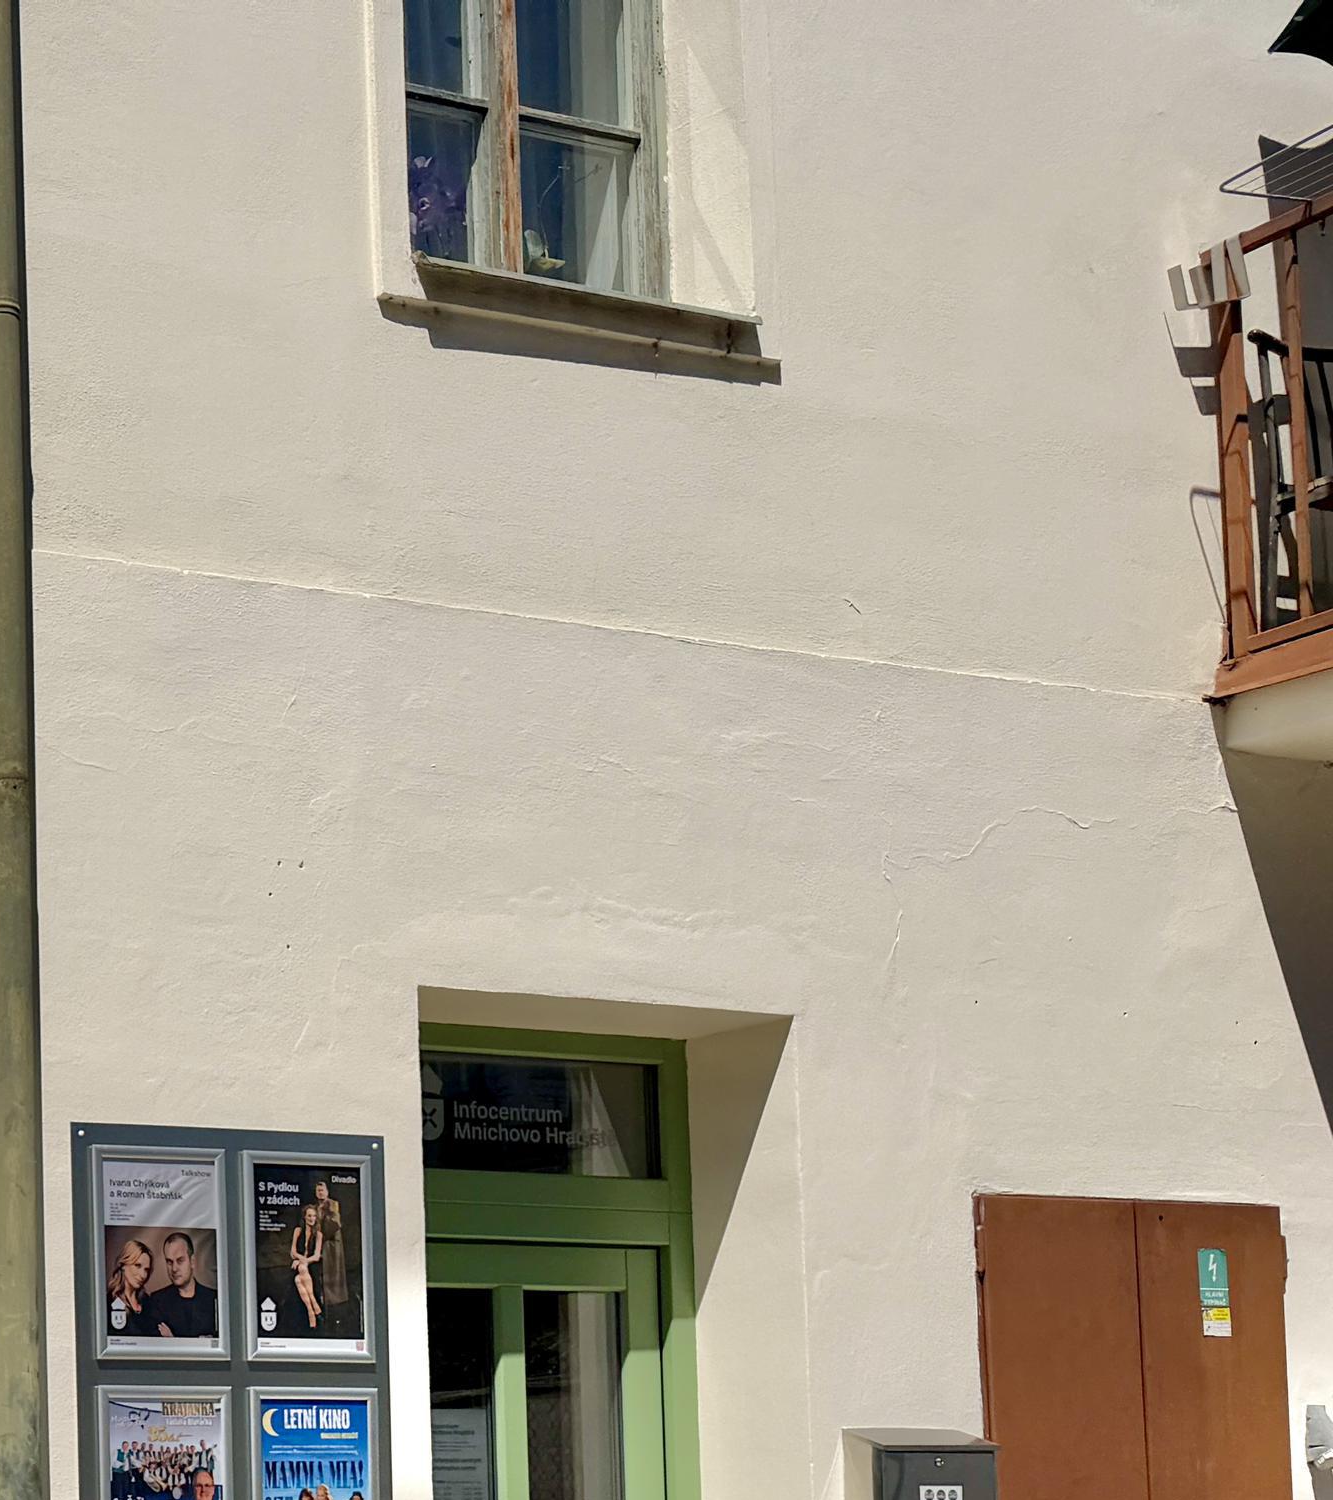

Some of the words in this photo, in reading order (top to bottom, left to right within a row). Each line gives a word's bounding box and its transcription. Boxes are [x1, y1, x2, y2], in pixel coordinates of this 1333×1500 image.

[453, 1100, 563, 1123] Infocentrum
[454, 1122, 541, 1143] Mnichovo
[181, 1169, 212, 1178] Talkshow
[331, 1175, 357, 1184] Divadlo
[109, 1179, 131, 1187] Ivana
[258, 1182, 266, 1191] S
[267, 1182, 299, 1193] Pydlou
[117, 1190, 145, 1199] Roman
[258, 1196, 266, 1204] v
[267, 1194, 300, 1206] zádech
[163, 1402, 214, 1416] KRAJANKA
[283, 1405, 317, 1429] LETNÍ
[319, 1408, 351, 1430] KINO
[264, 1460, 326, 1488] MAMMA
[329, 1460, 364, 1488] MIA!
